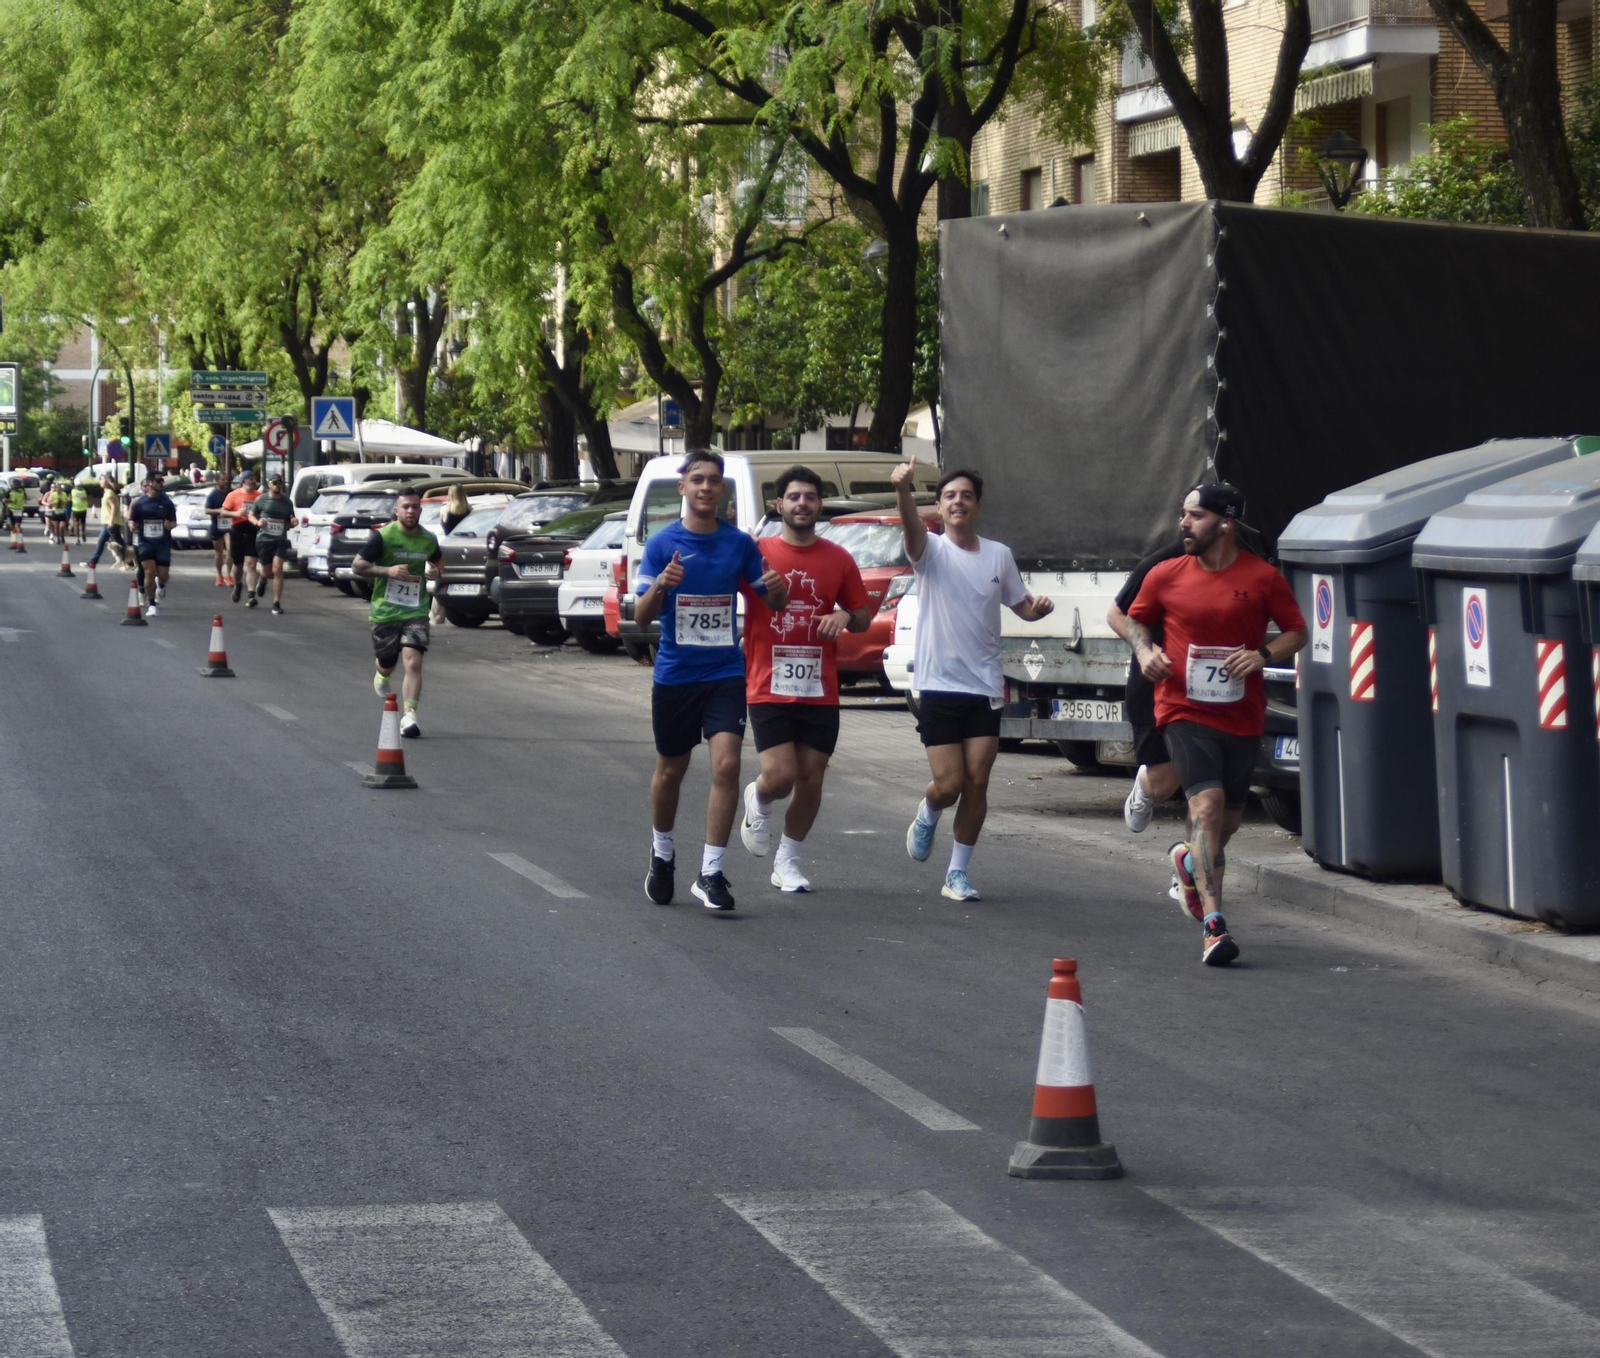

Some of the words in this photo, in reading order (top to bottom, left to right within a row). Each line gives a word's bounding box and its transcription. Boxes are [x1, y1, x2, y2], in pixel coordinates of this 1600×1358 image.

[397, 584, 410, 596] 71
[689, 613, 721, 629] 785
[784, 663, 814, 679] 307
[1206, 665, 1230, 683] 79
[1062, 702, 1092, 719] 3956
[1096, 704, 1119, 721] CVR
